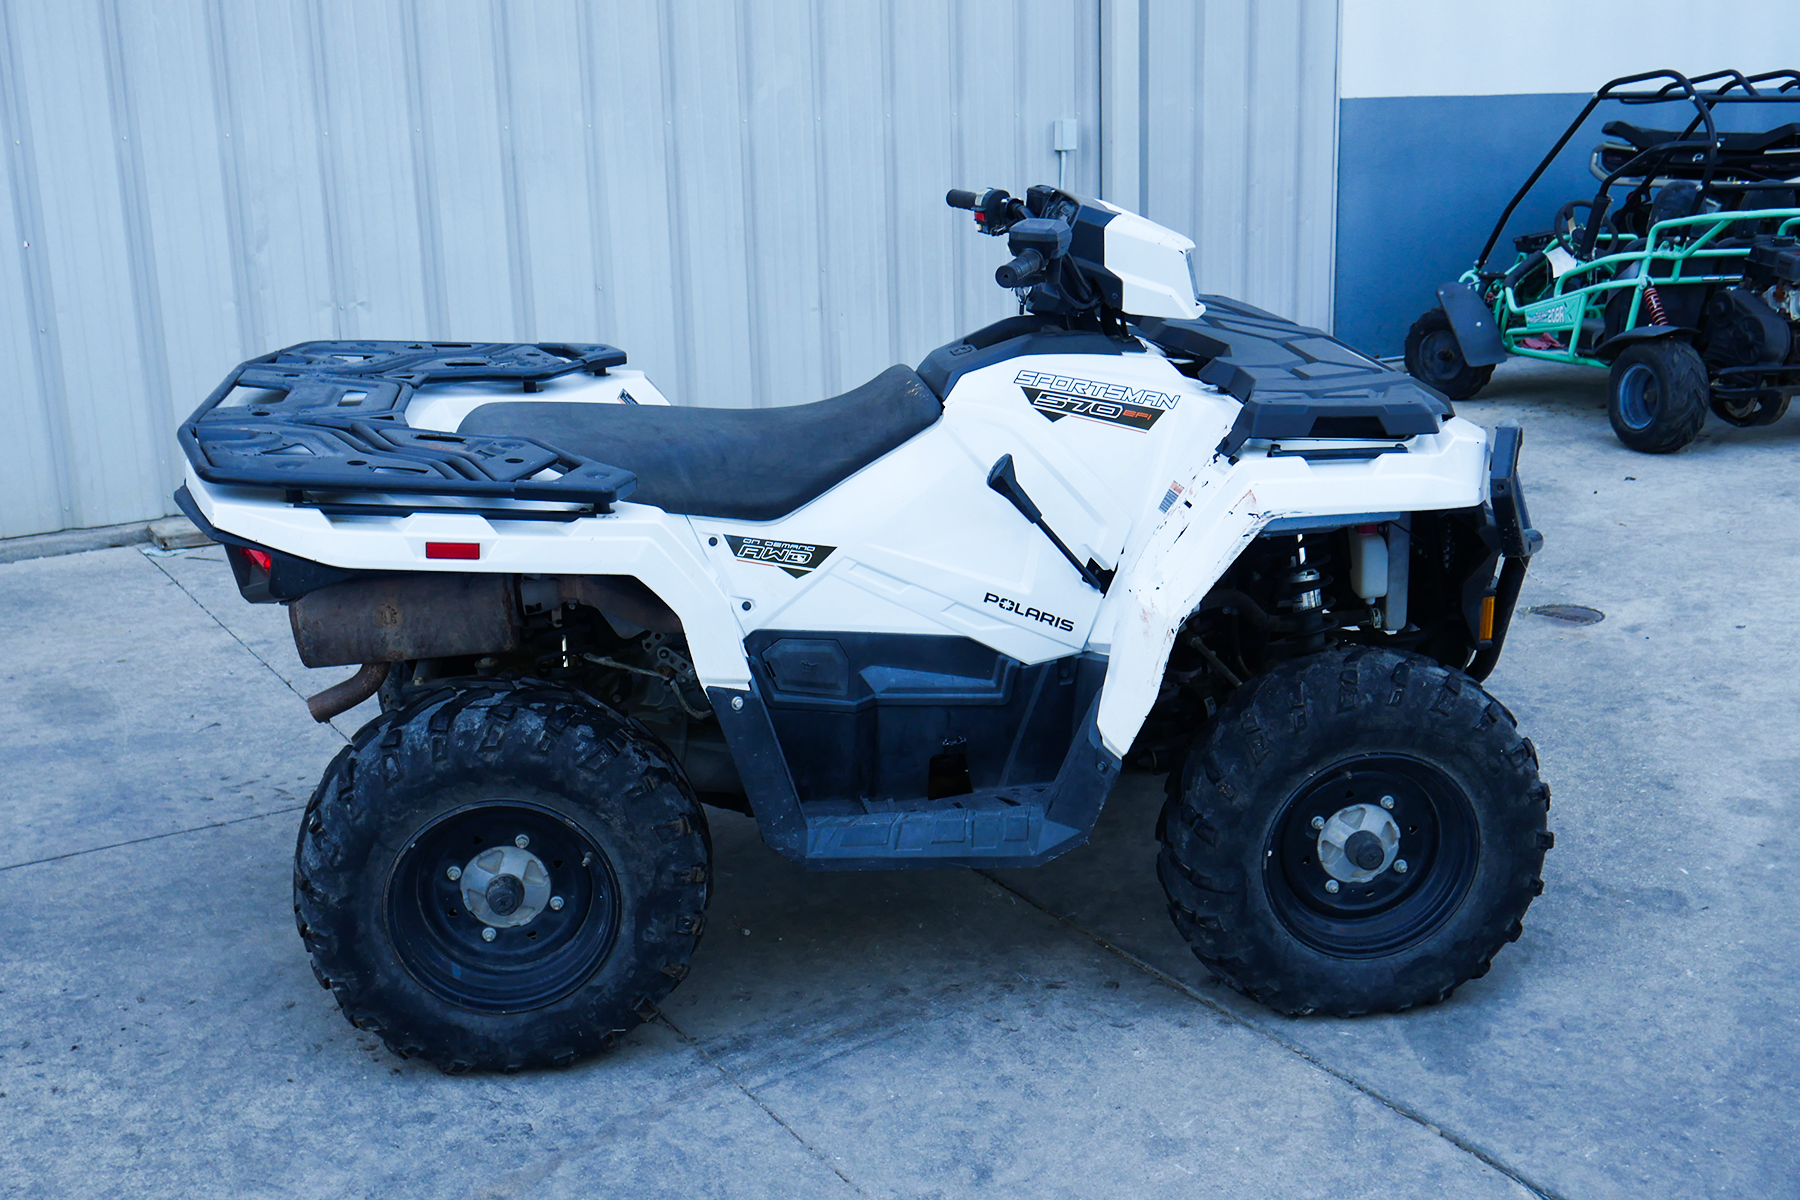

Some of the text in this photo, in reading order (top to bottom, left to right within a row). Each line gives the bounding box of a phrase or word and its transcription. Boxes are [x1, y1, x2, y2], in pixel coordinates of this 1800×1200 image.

[1013, 370, 1181, 410] SPORTSMAN
[1033, 391, 1123, 419] 570
[737, 544, 813, 564] AWD
[983, 592, 1075, 632] POLARIS
